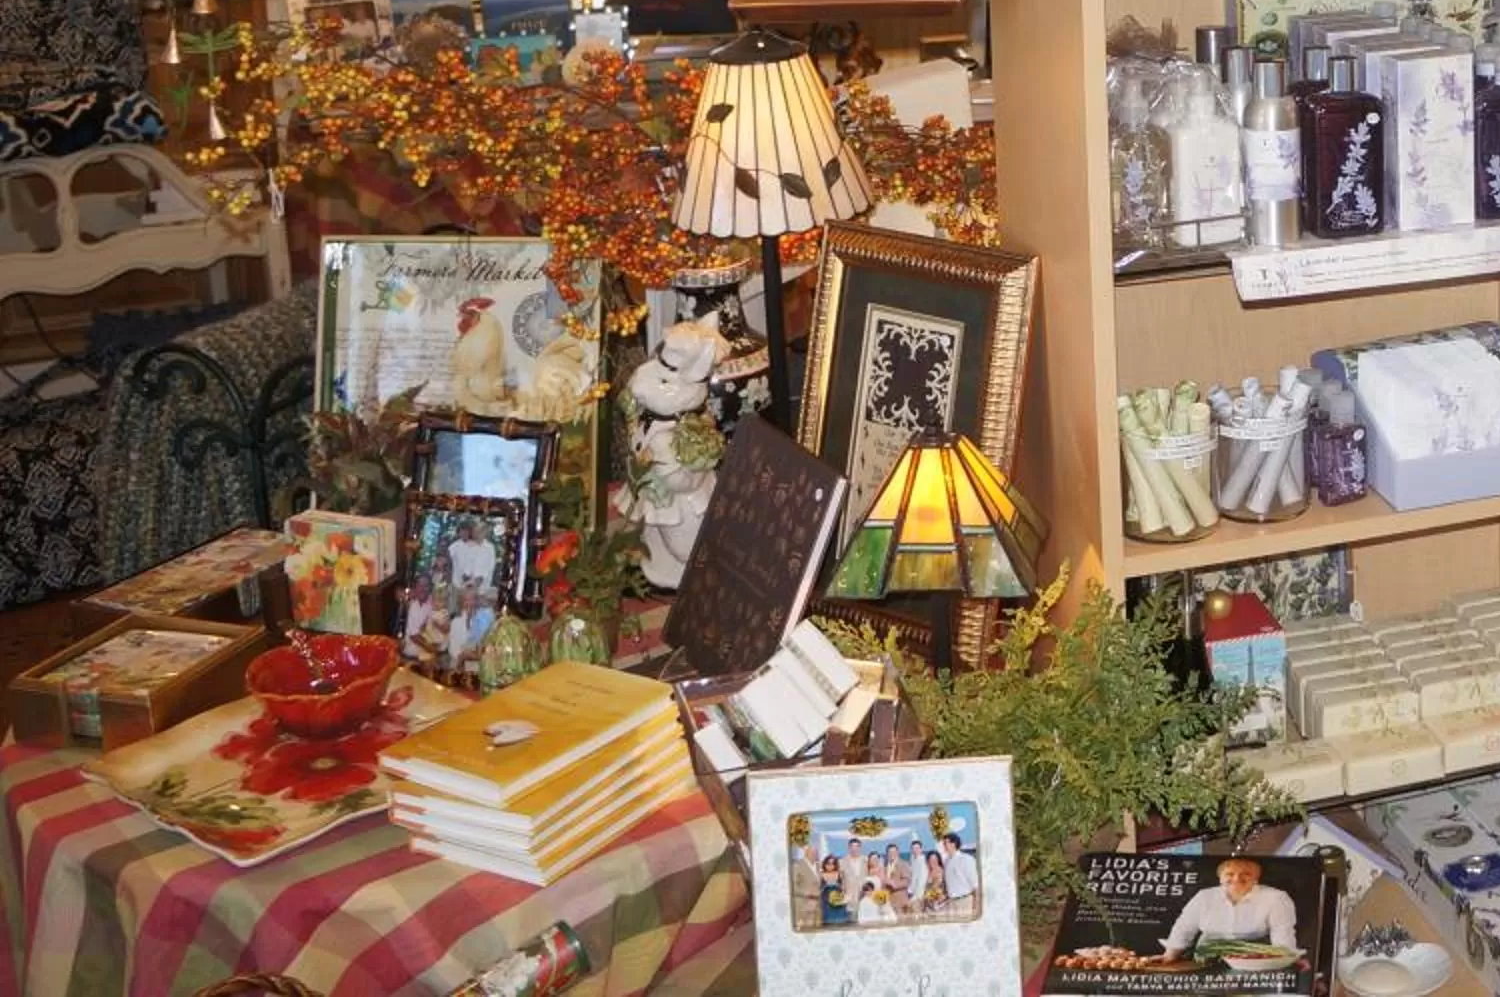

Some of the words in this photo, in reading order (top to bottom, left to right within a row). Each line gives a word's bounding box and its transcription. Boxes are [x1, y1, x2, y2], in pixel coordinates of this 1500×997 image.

[464, 256, 549, 282] Market
[1091, 857, 1169, 870] LIDIA'S
[1088, 869, 1199, 884] FAVORITE
[1087, 882, 1184, 896] RECIPES
[1062, 972, 1102, 982] LIDIA
